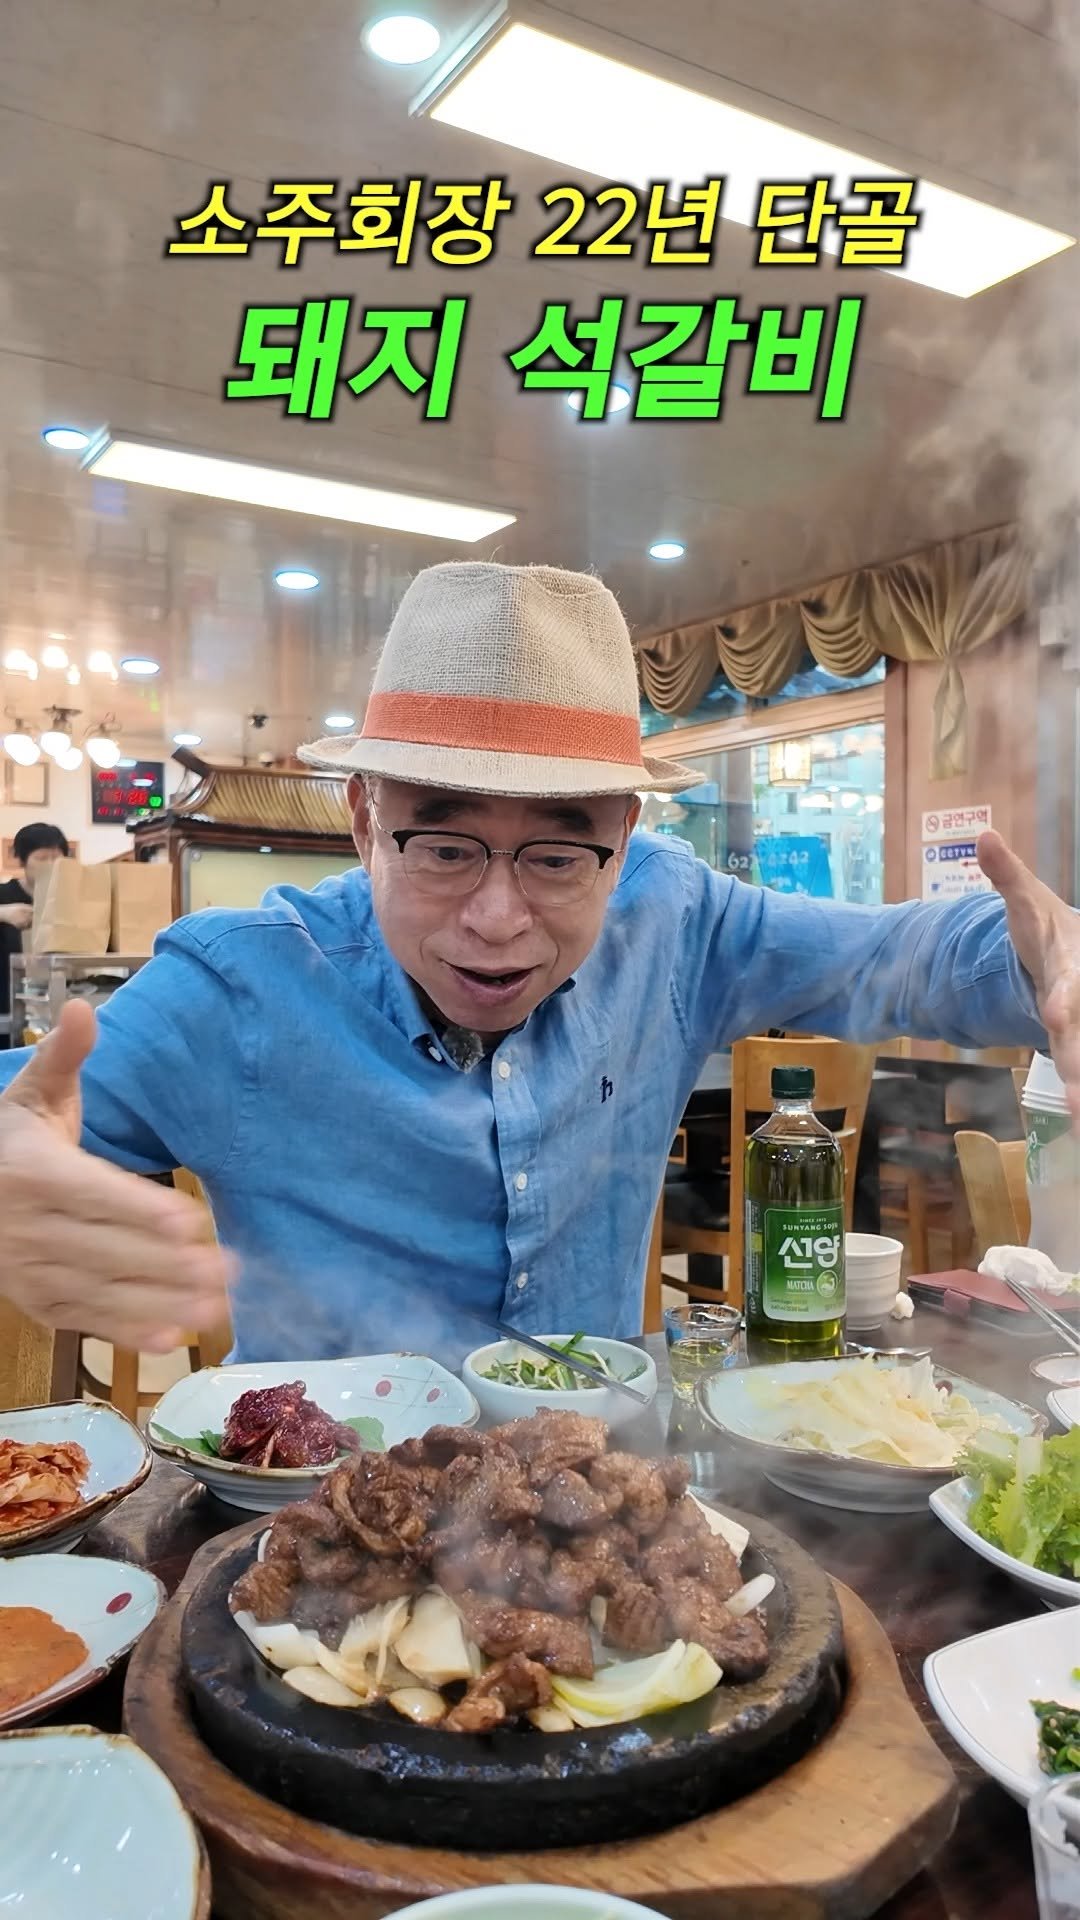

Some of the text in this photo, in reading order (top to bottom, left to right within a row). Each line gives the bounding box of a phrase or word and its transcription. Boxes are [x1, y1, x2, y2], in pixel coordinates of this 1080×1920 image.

[942, 808, 988, 829] 금연구역
[782, 1223, 822, 1231] SUNYANG
[777, 1234, 841, 1269] 선양
[786, 1279, 815, 1291] MATCHA
